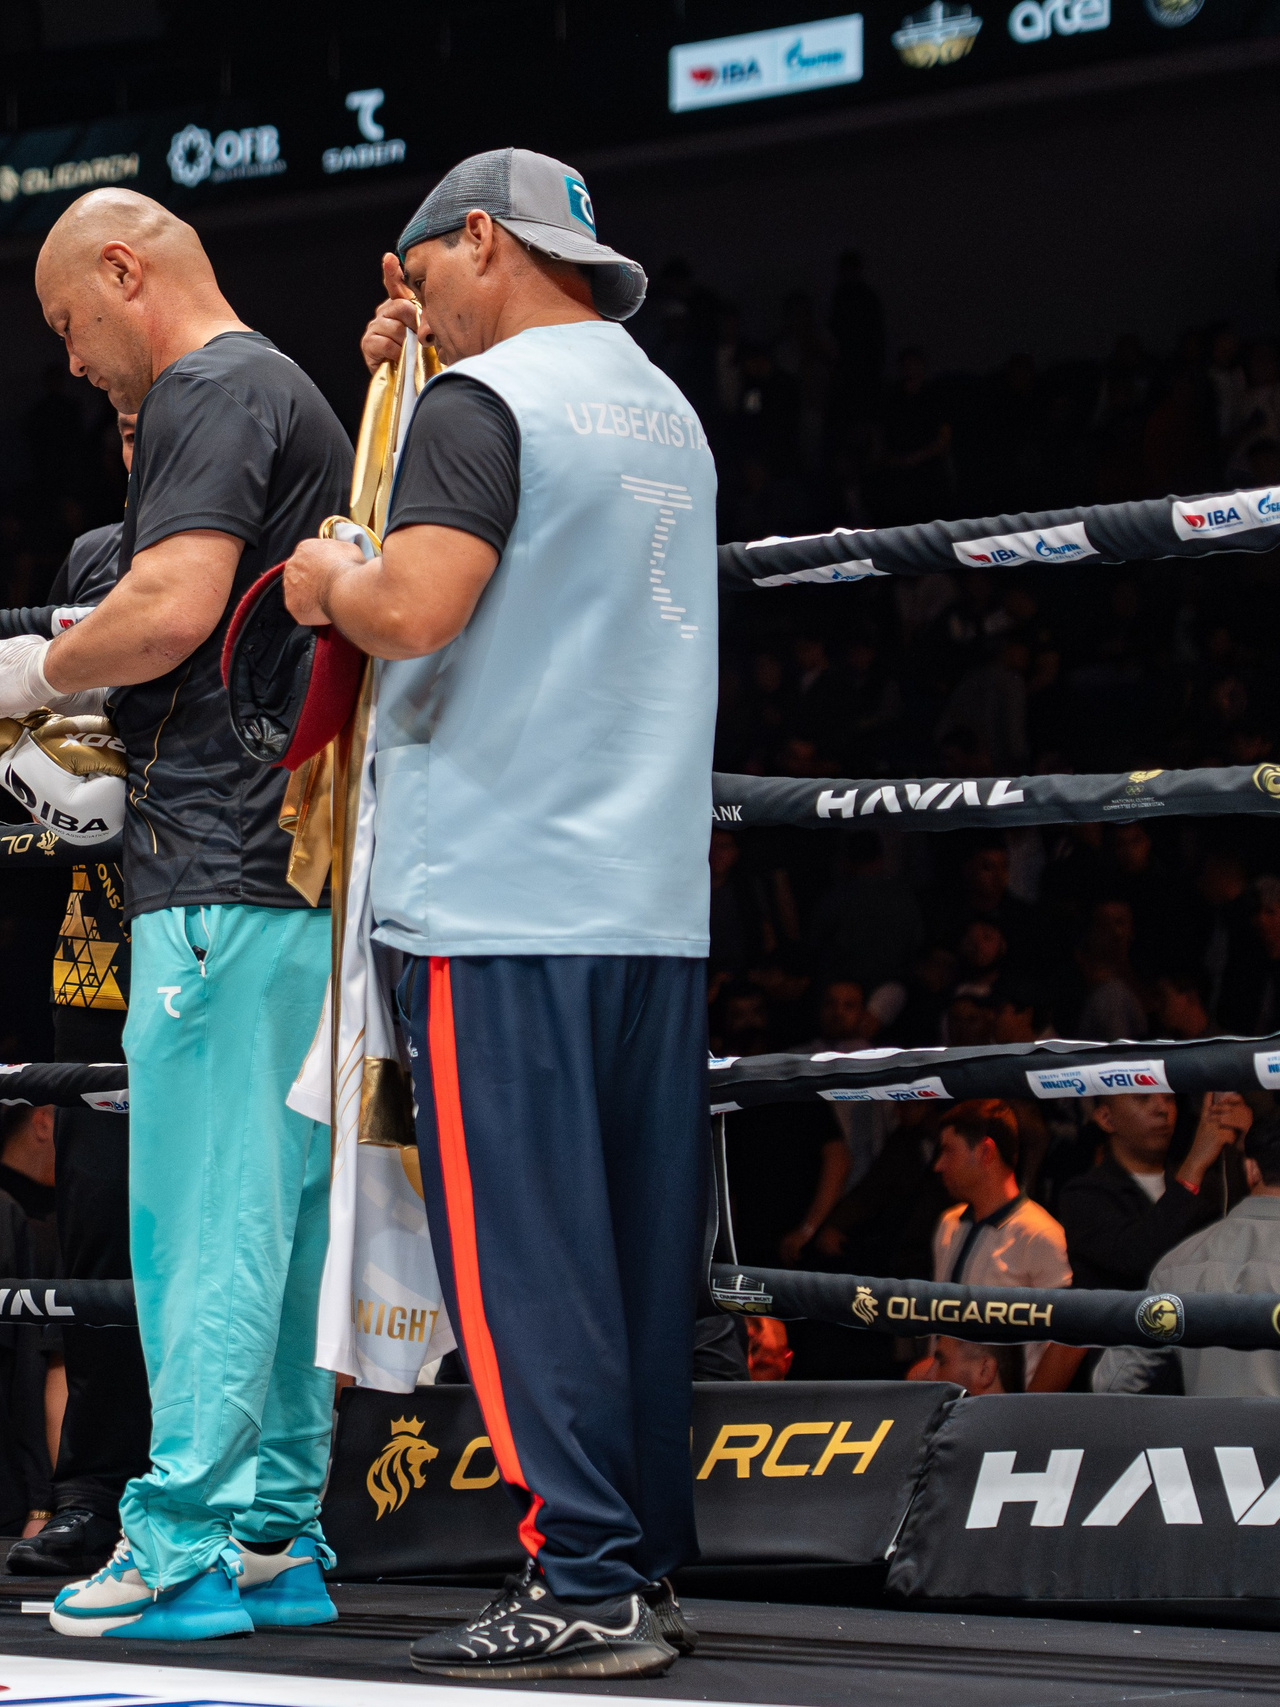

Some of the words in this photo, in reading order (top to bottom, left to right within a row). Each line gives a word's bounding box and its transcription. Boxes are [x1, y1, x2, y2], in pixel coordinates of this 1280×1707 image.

[1207, 507, 1241, 526] IBA
[816, 780, 1024, 818] HAVAL
[40, 801, 109, 833] IBA
[1100, 1074, 1135, 1087] IBA
[357, 1299, 438, 1343] NIGHT
[886, 1296, 1054, 1327] OLIGARCH
